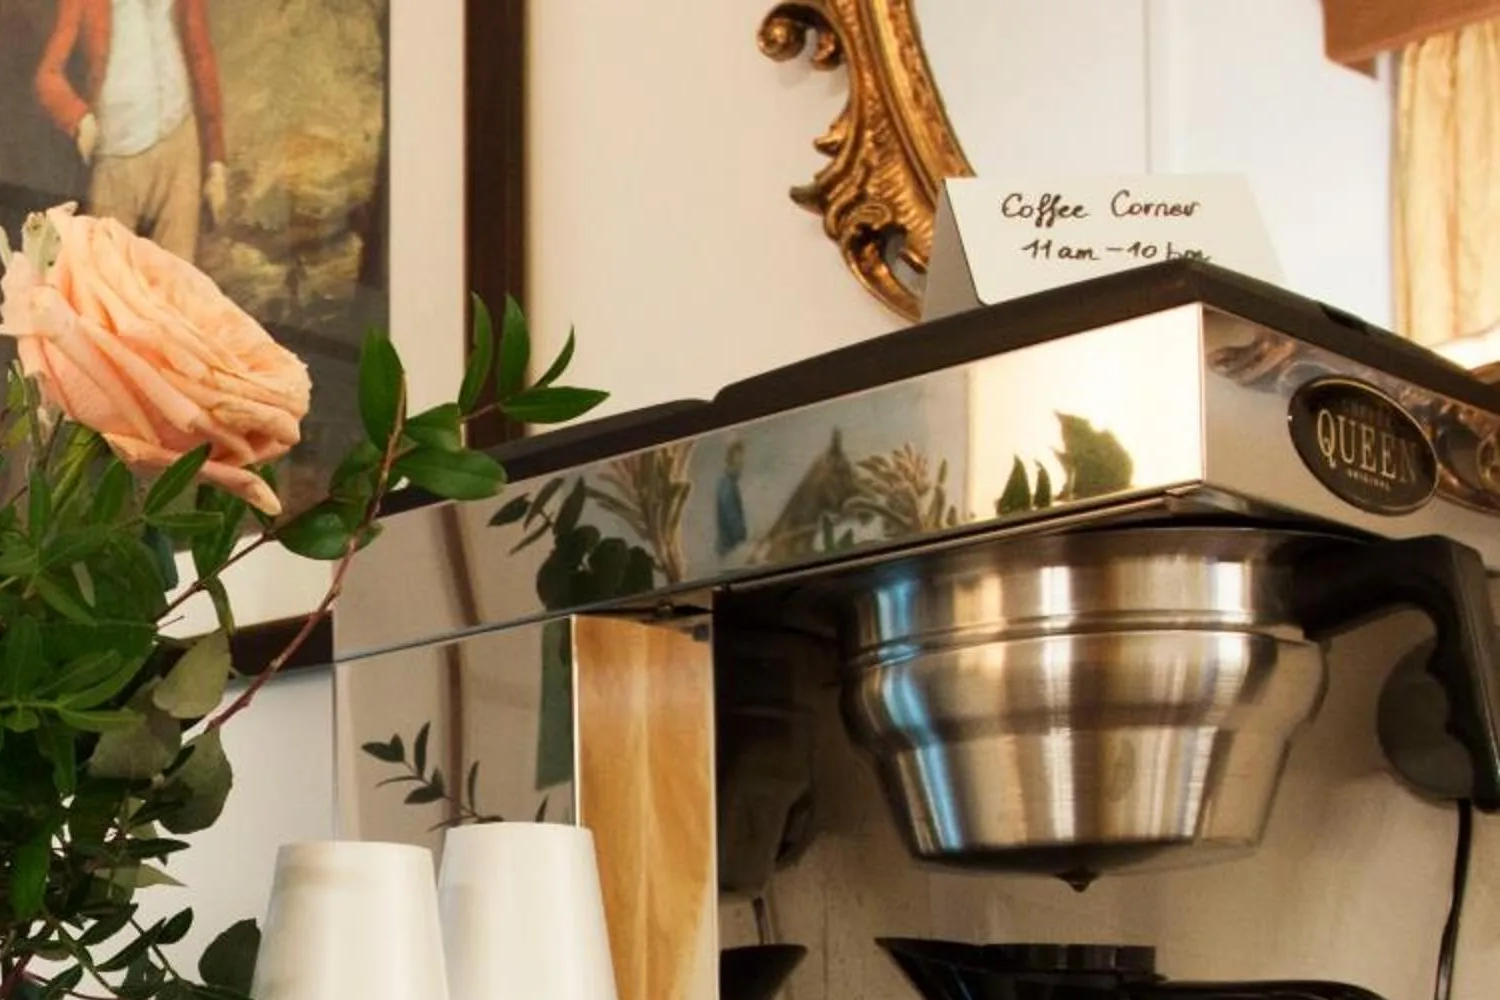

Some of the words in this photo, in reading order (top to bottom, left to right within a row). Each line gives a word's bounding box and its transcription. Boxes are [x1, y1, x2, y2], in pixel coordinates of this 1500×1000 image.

[1001, 192, 1091, 228] Coffee
[1110, 189, 1200, 218] Corner
[1317, 408, 1419, 485] QUEEN
